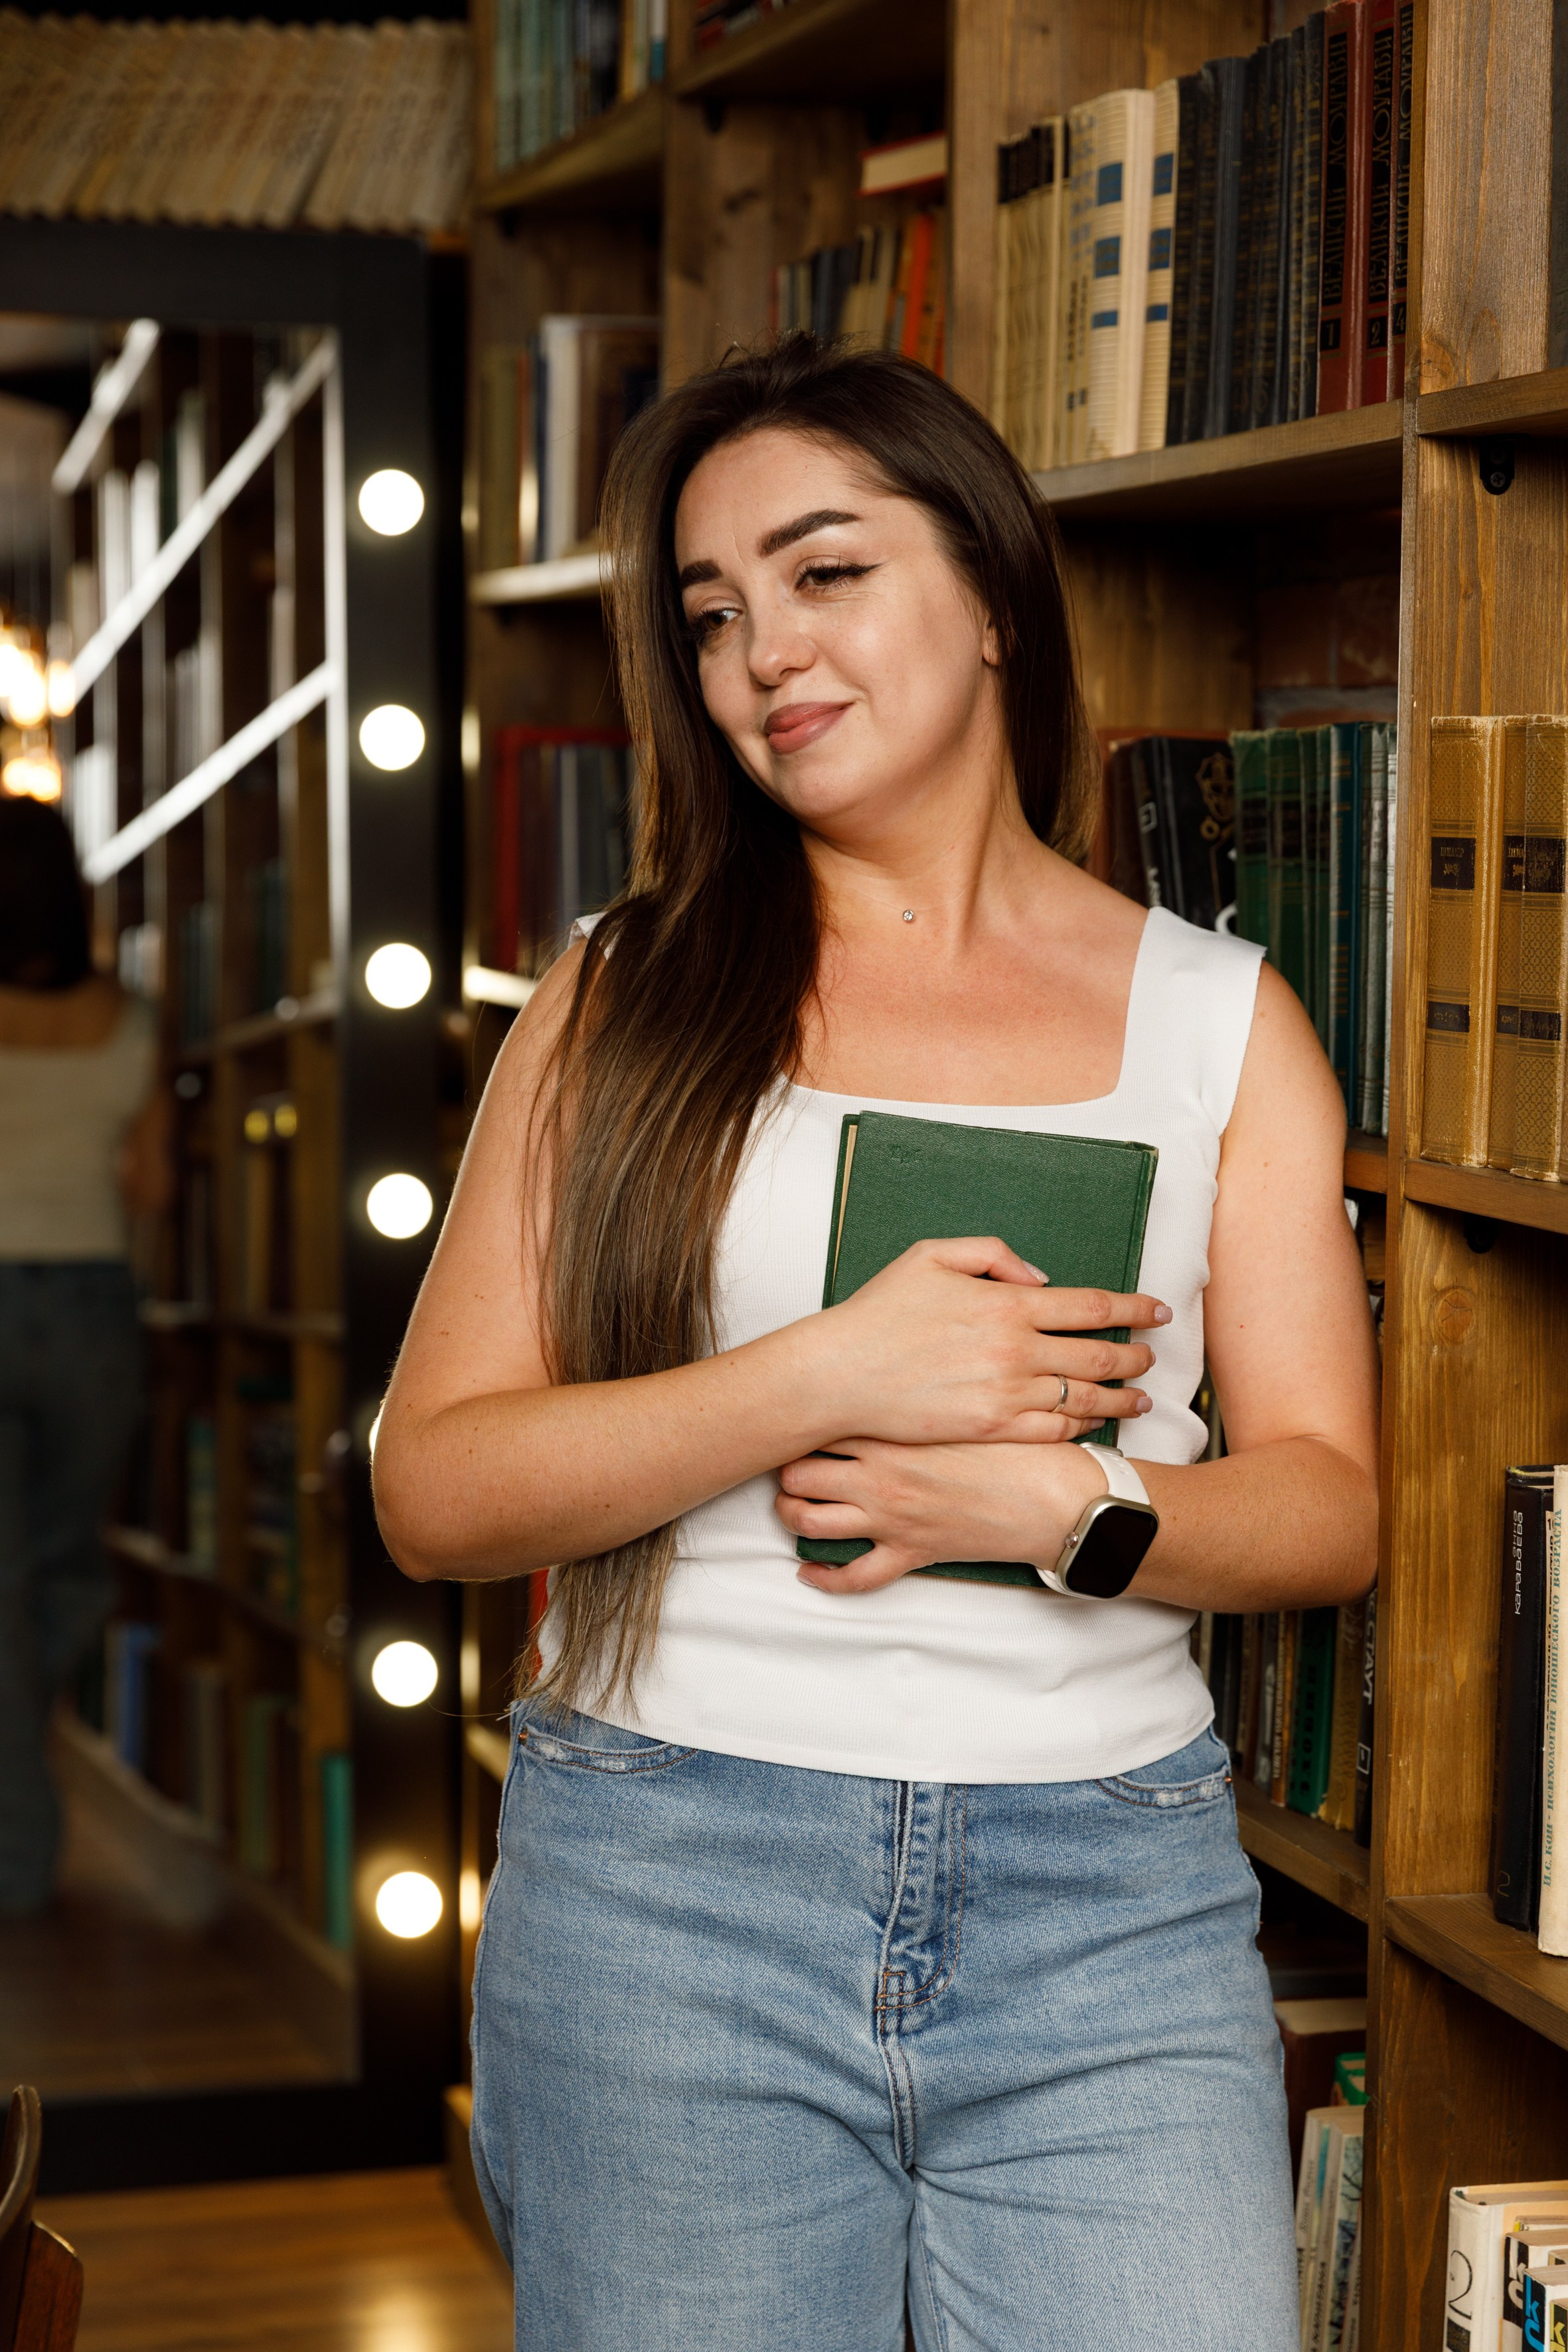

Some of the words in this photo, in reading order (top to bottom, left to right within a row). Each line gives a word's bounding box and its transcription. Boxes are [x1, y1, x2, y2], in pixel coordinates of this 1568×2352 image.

[1329, 40, 1346, 169] МОУРАВИ
[1372, 35, 1392, 166] МОУРАВИ
[1324, 187, 1346, 299] ВЕЛИКИЙ
[1369, 183, 1389, 297] ВЕЛИКИЙ
[1326, 323, 1334, 346] 1
[1370, 321, 1381, 345] 2
[1396, 307, 1406, 331] 4
[1553, 1509, 1562, 1588] ВОЗРАСТА
[1363, 1620, 1375, 1705] СТАУТ
[1549, 1595, 1560, 1703] ЮНОШЕСКОГО
[1547, 1709, 1557, 1811] ПСИХОЛОГИЯ
